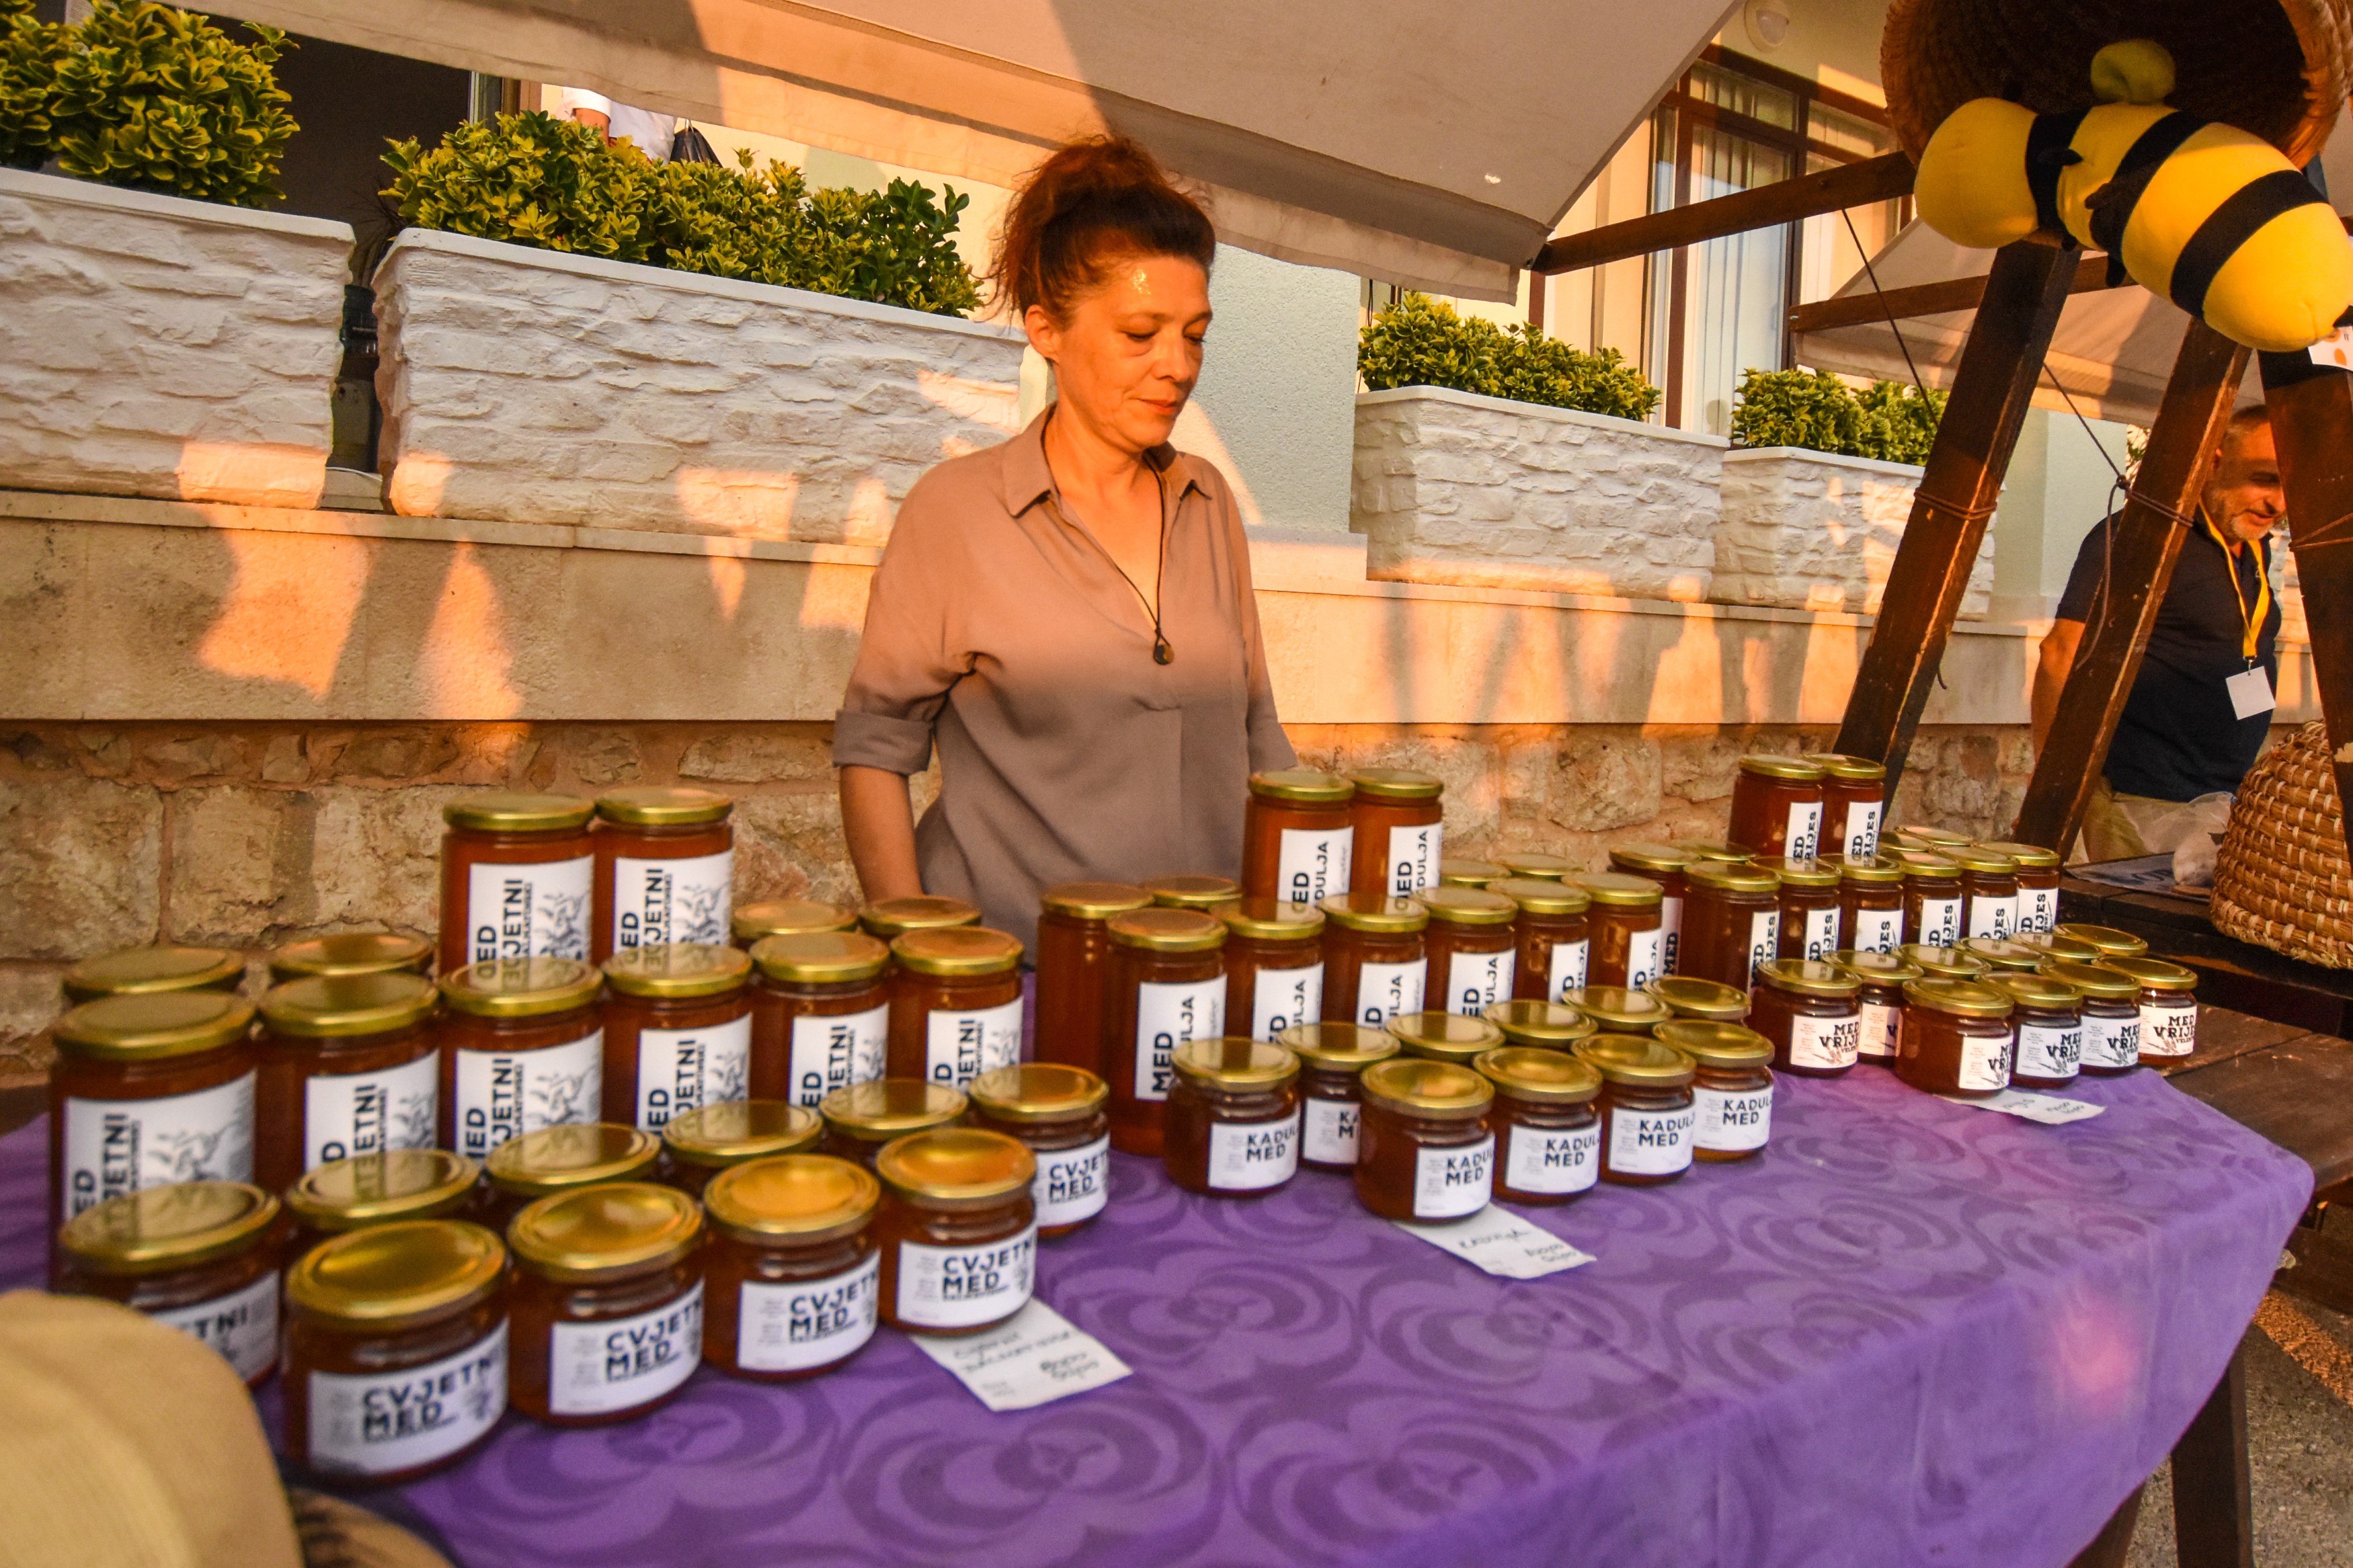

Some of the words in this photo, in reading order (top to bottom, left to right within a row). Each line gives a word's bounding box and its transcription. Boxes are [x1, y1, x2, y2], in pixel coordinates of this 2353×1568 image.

[1417, 830, 1429, 886] DULJA
[1792, 837, 1804, 858] ED
[1292, 872, 1309, 903] ED
[1314, 841, 1329, 900] DULJA
[1396, 862, 1412, 898] ED
[502, 879, 523, 956] JETNI
[643, 868, 664, 944] JETNI
[2035, 893, 2046, 931] IJES
[477, 925, 497, 962] ED
[621, 912, 639, 948] ED
[1765, 916, 1776, 958] IJES
[1822, 914, 1833, 953] IJES
[492, 1058, 512, 1143] JETNI
[801, 1071, 822, 1107] ED
[354, 1083, 377, 1151] ETNI
[647, 1088, 670, 1128] ED
[1722, 1112, 1759, 1126] MED
[1246, 1143, 1286, 1162] MED
[1638, 1132, 1679, 1147] MED
[1445, 1167, 1484, 1187] MED
[1545, 1151, 1585, 1167] MED
[1049, 1175, 1092, 1199] MED
[943, 1272, 1000, 1293] MED
[789, 1307, 848, 1341] MED
[606, 1339, 671, 1380] MED
